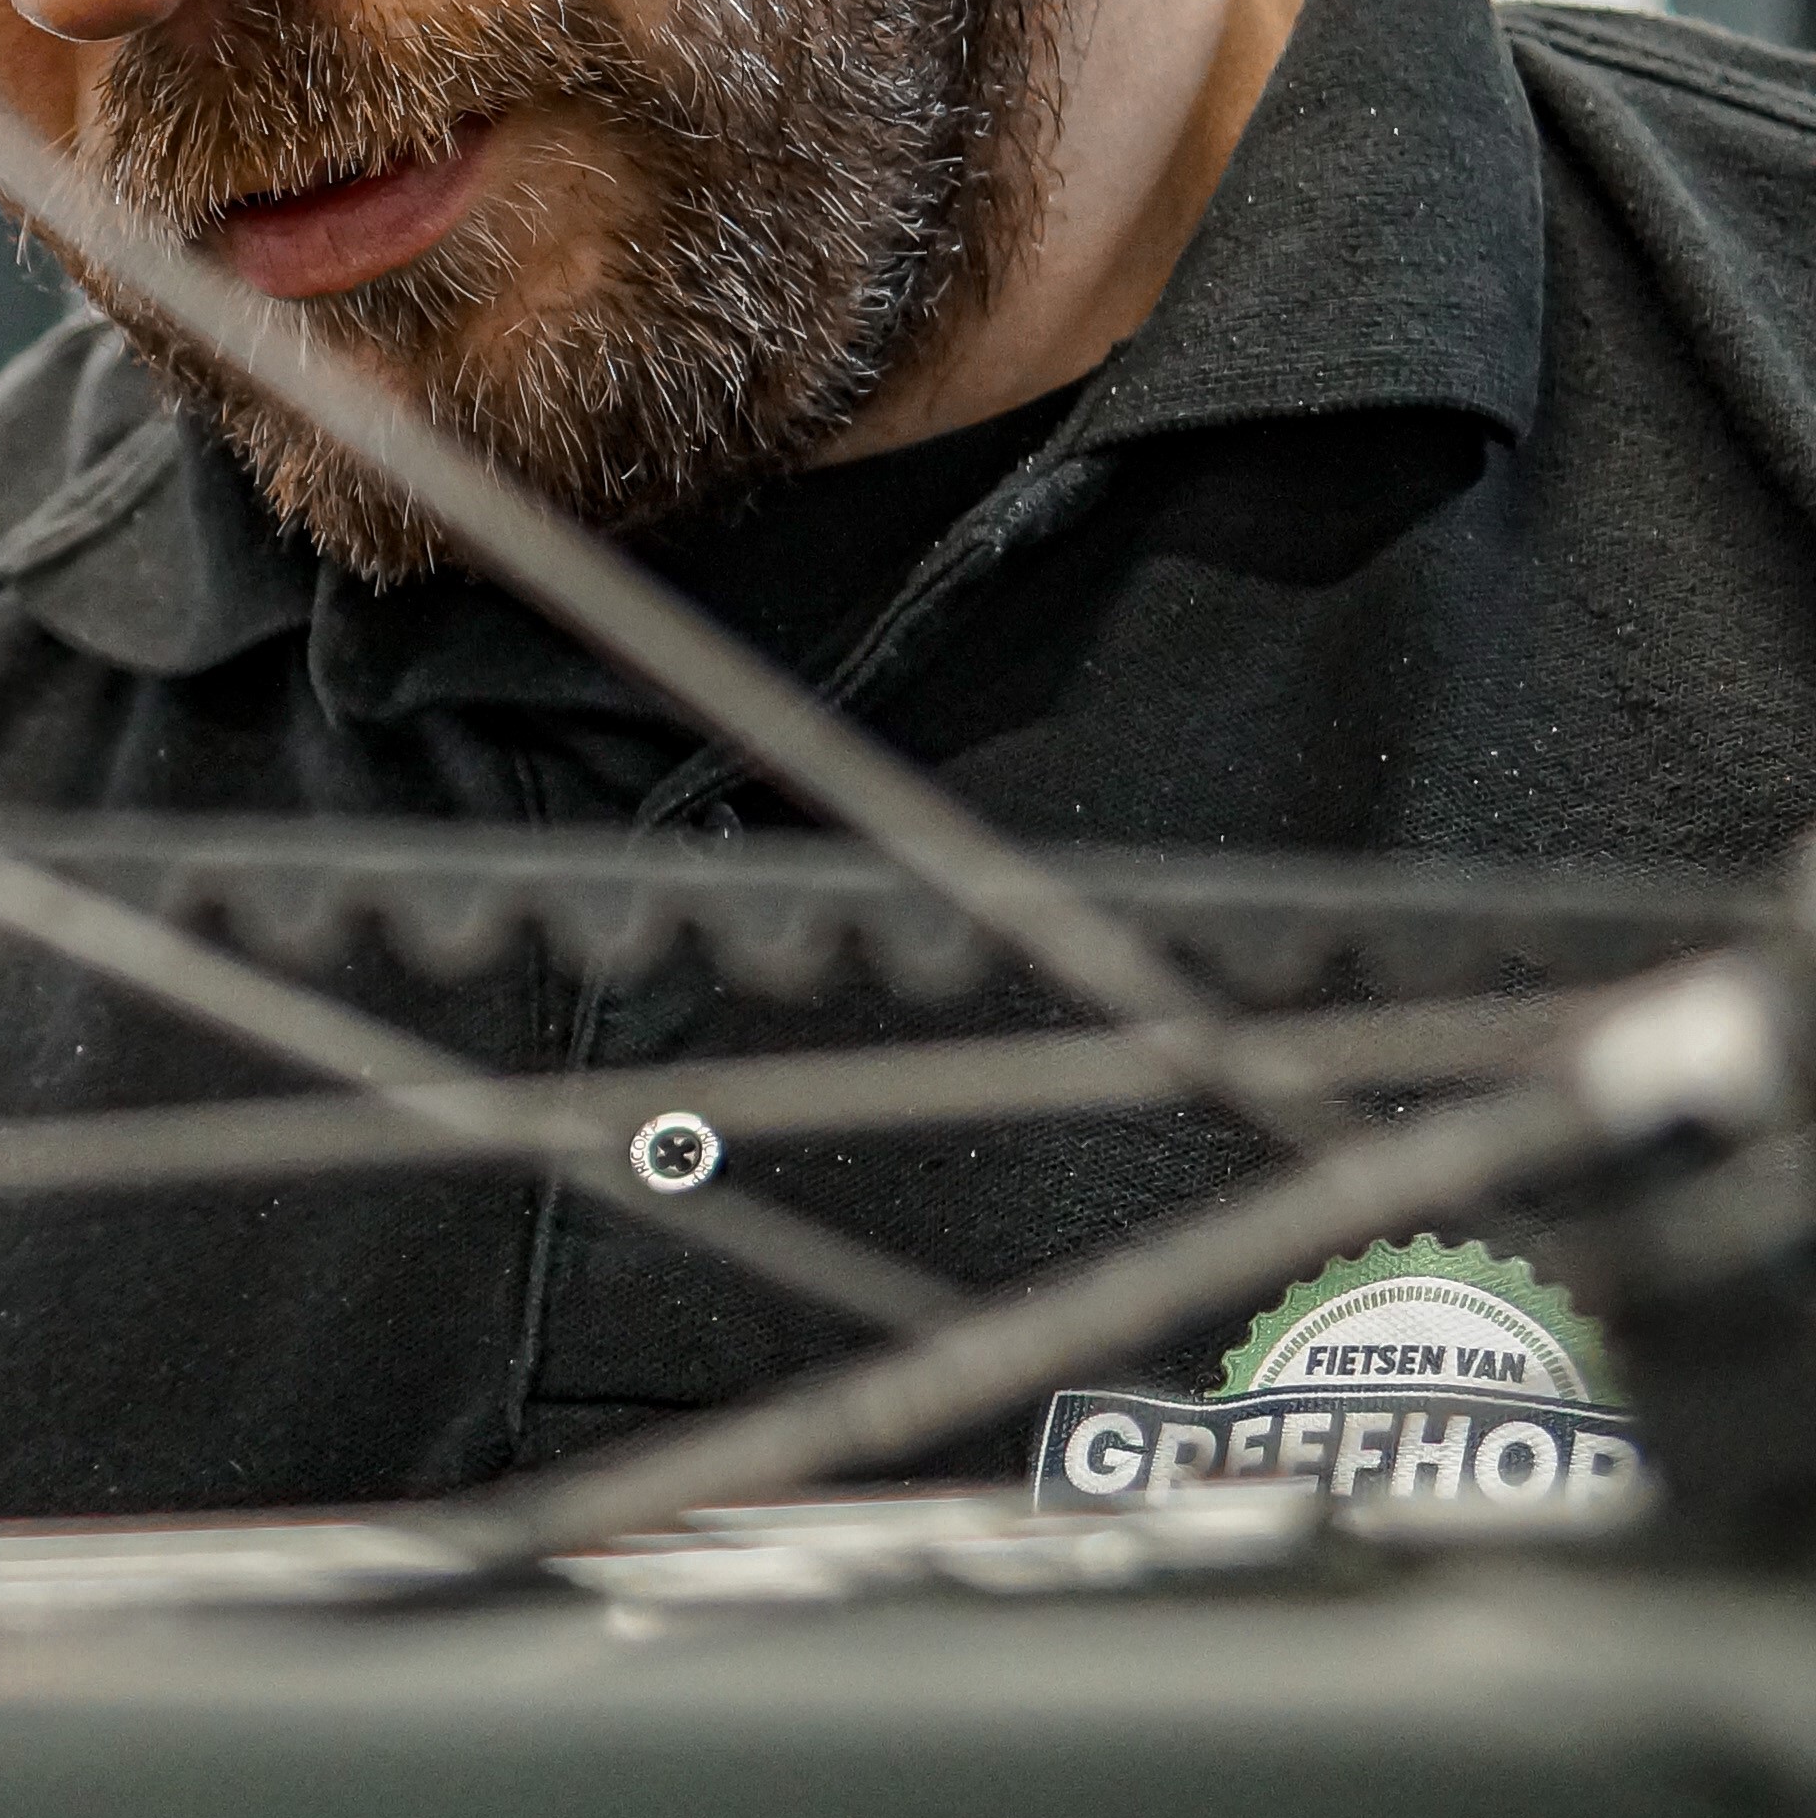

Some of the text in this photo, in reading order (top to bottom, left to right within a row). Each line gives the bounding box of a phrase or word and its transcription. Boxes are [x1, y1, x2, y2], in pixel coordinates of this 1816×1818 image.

[1304, 1344, 1528, 1385] FIETSEN VAN
[1063, 1411, 1646, 1507] GREEFHOR
